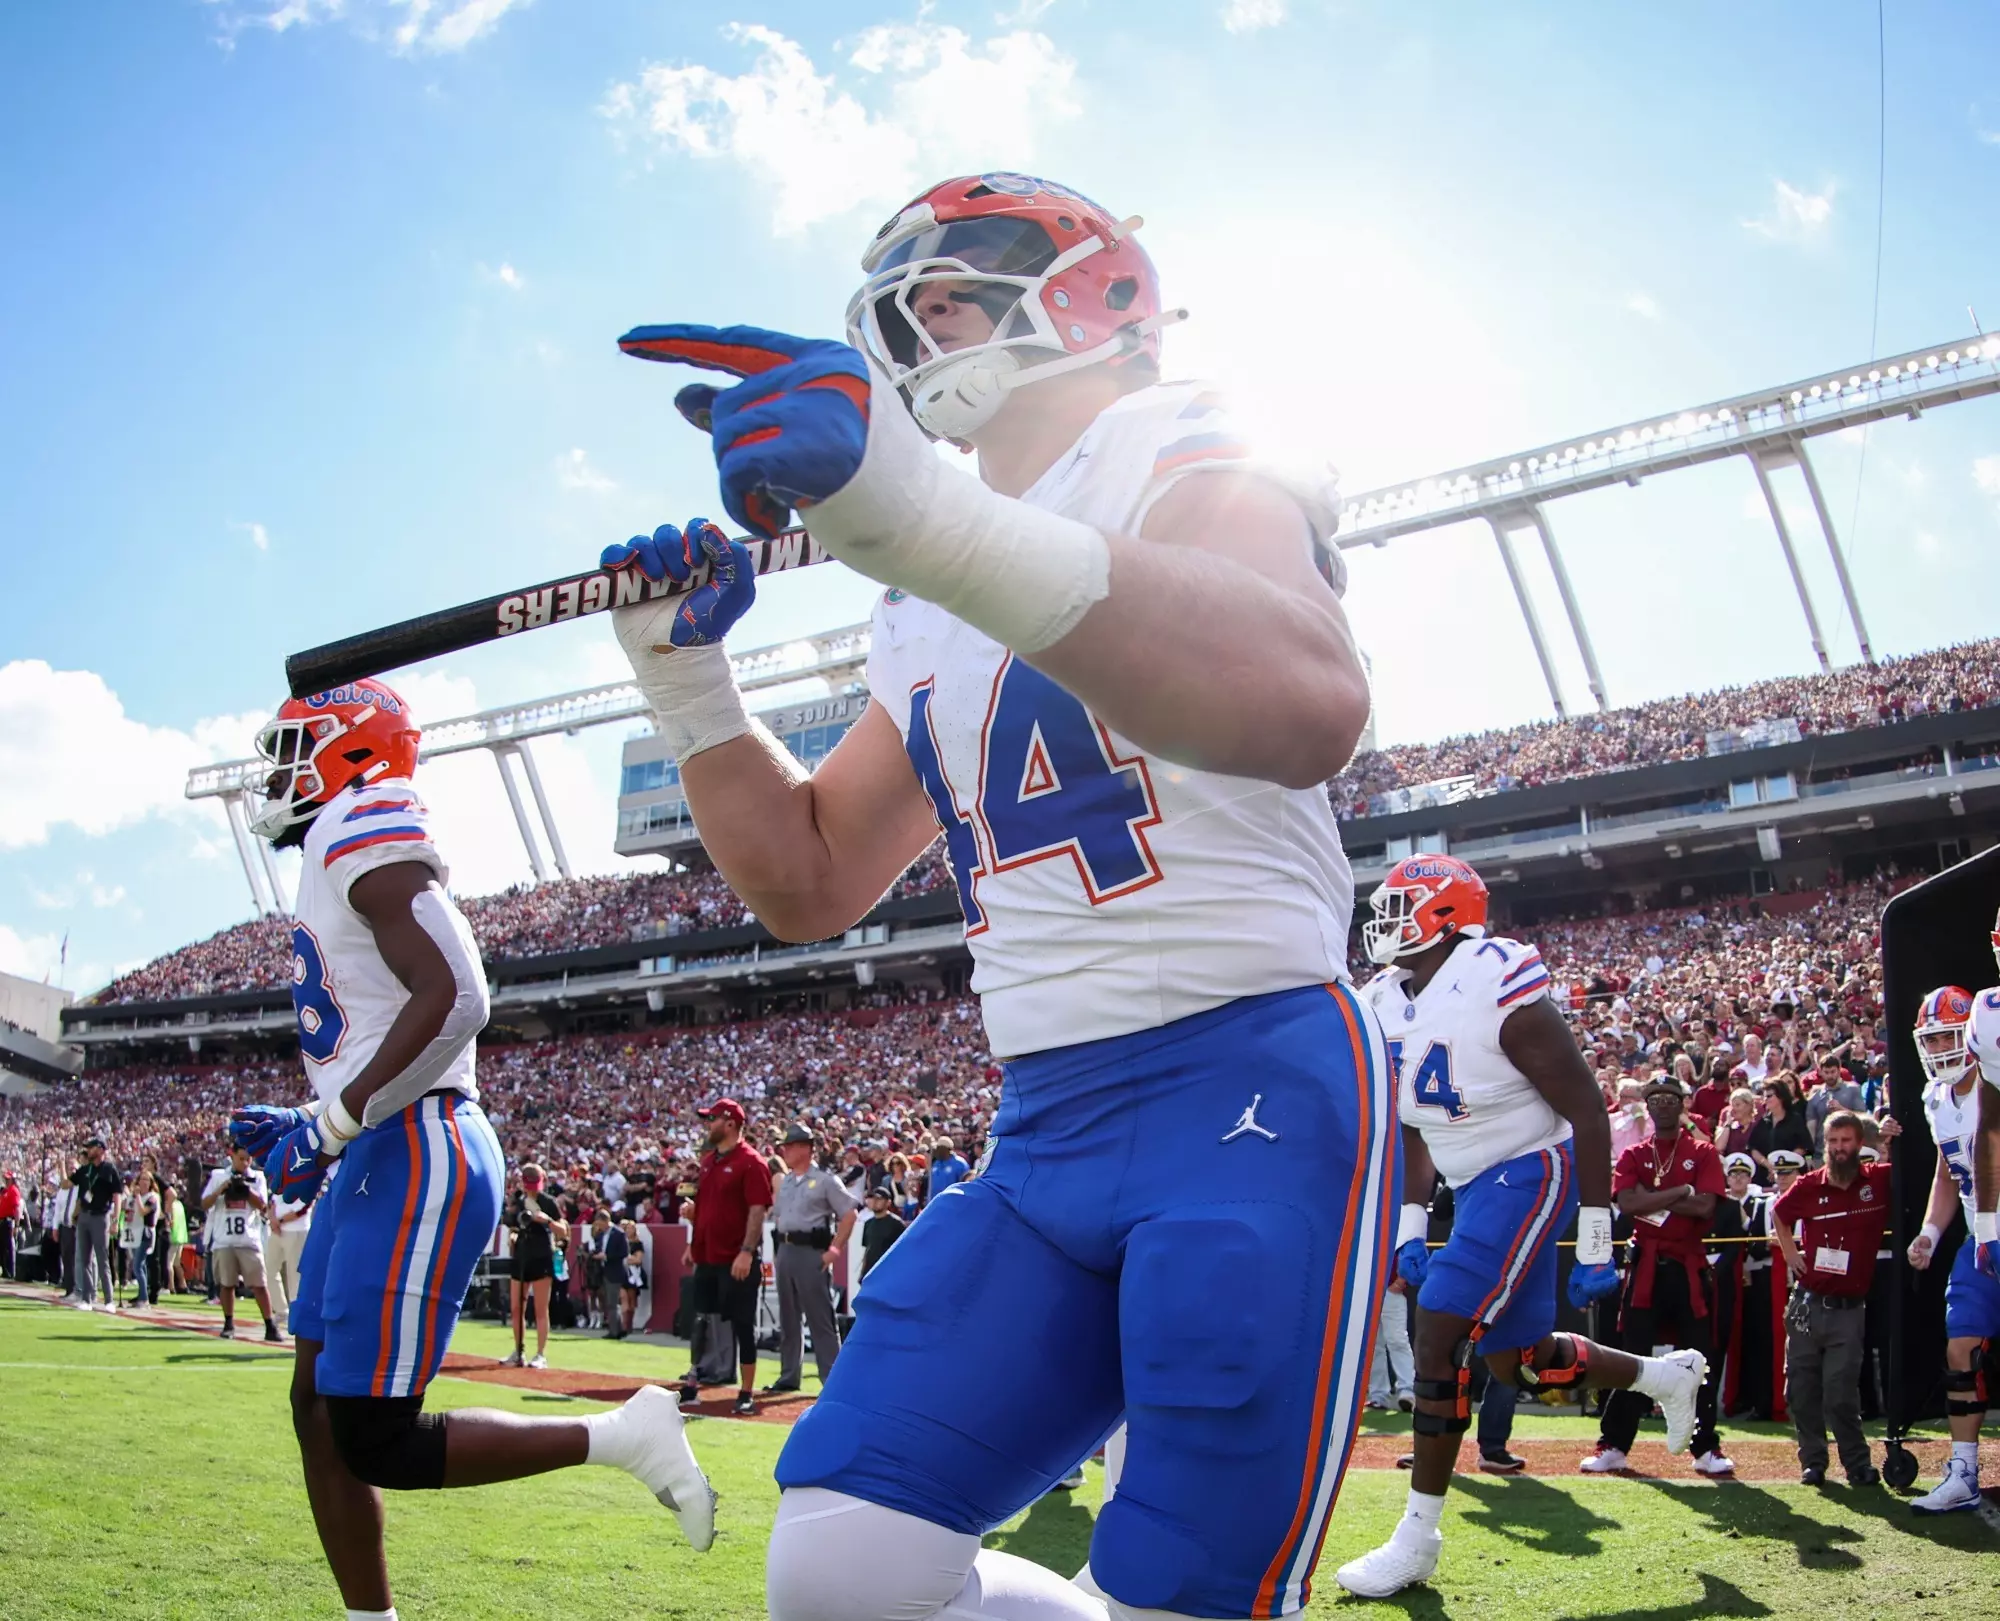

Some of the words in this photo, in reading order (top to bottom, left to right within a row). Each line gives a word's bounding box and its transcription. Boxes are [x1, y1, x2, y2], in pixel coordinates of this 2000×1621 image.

[306, 684, 401, 715] Gators
[793, 700, 848, 726] SOUTH
[1403, 861, 1473, 884] Gators
[1938, 1133, 1975, 1198] 5
[225, 1216, 245, 1235] 18
